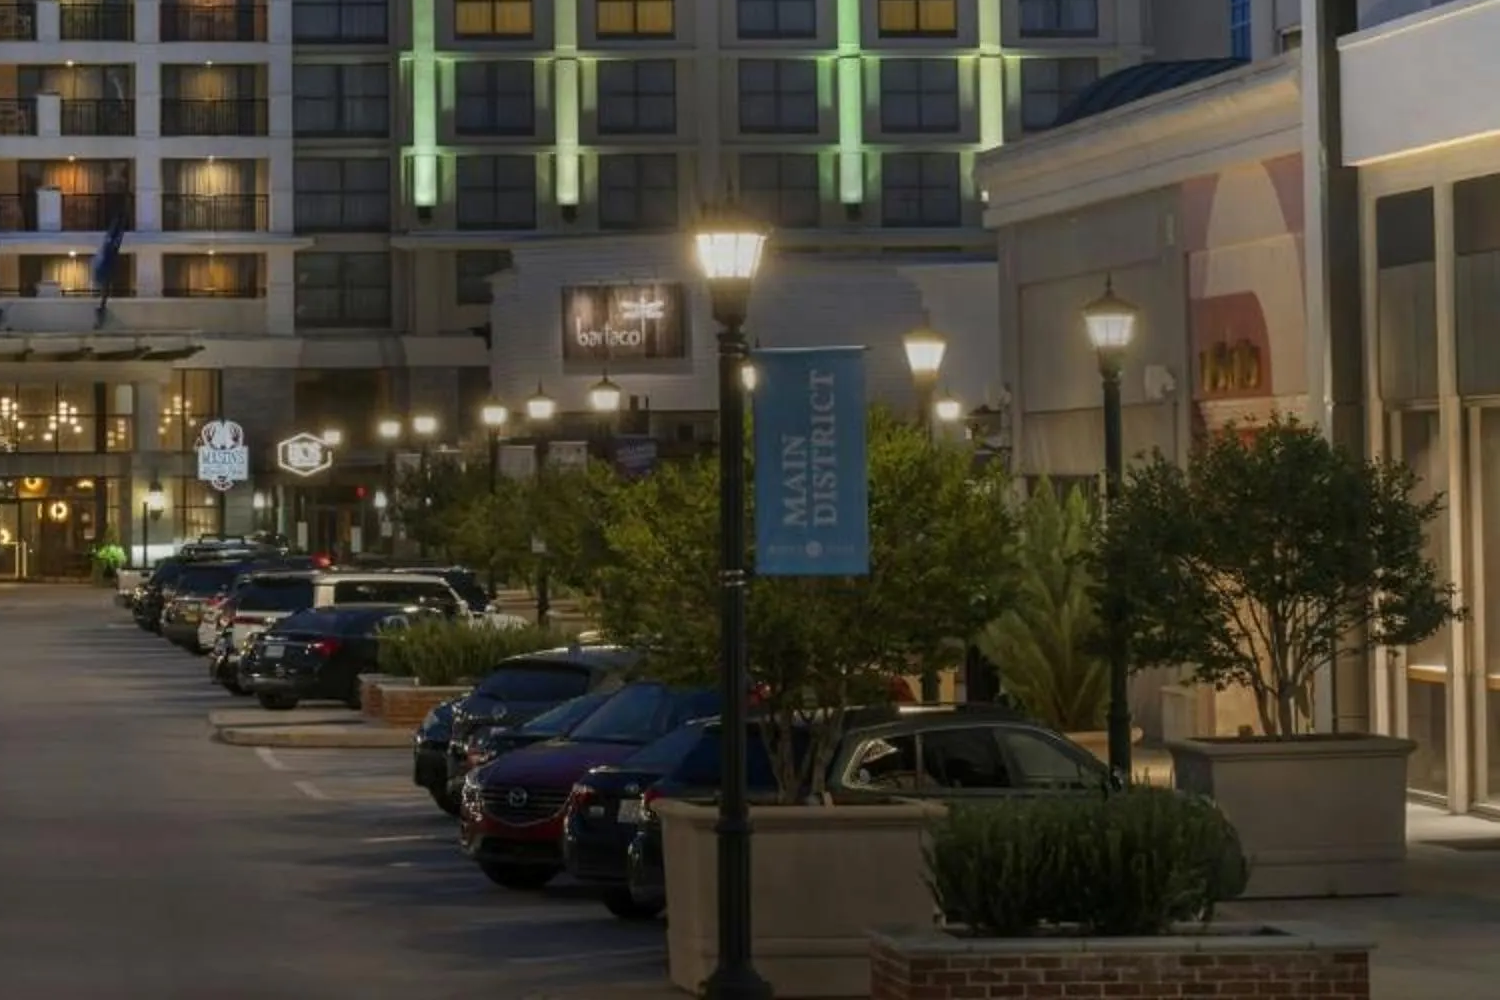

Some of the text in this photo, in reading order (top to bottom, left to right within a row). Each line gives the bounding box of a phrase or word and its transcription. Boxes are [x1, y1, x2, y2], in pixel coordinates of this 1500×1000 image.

[576, 315, 641, 347] bartaco
[781, 433, 808, 528] MAIN
[810, 369, 838, 528] DISTRICT
